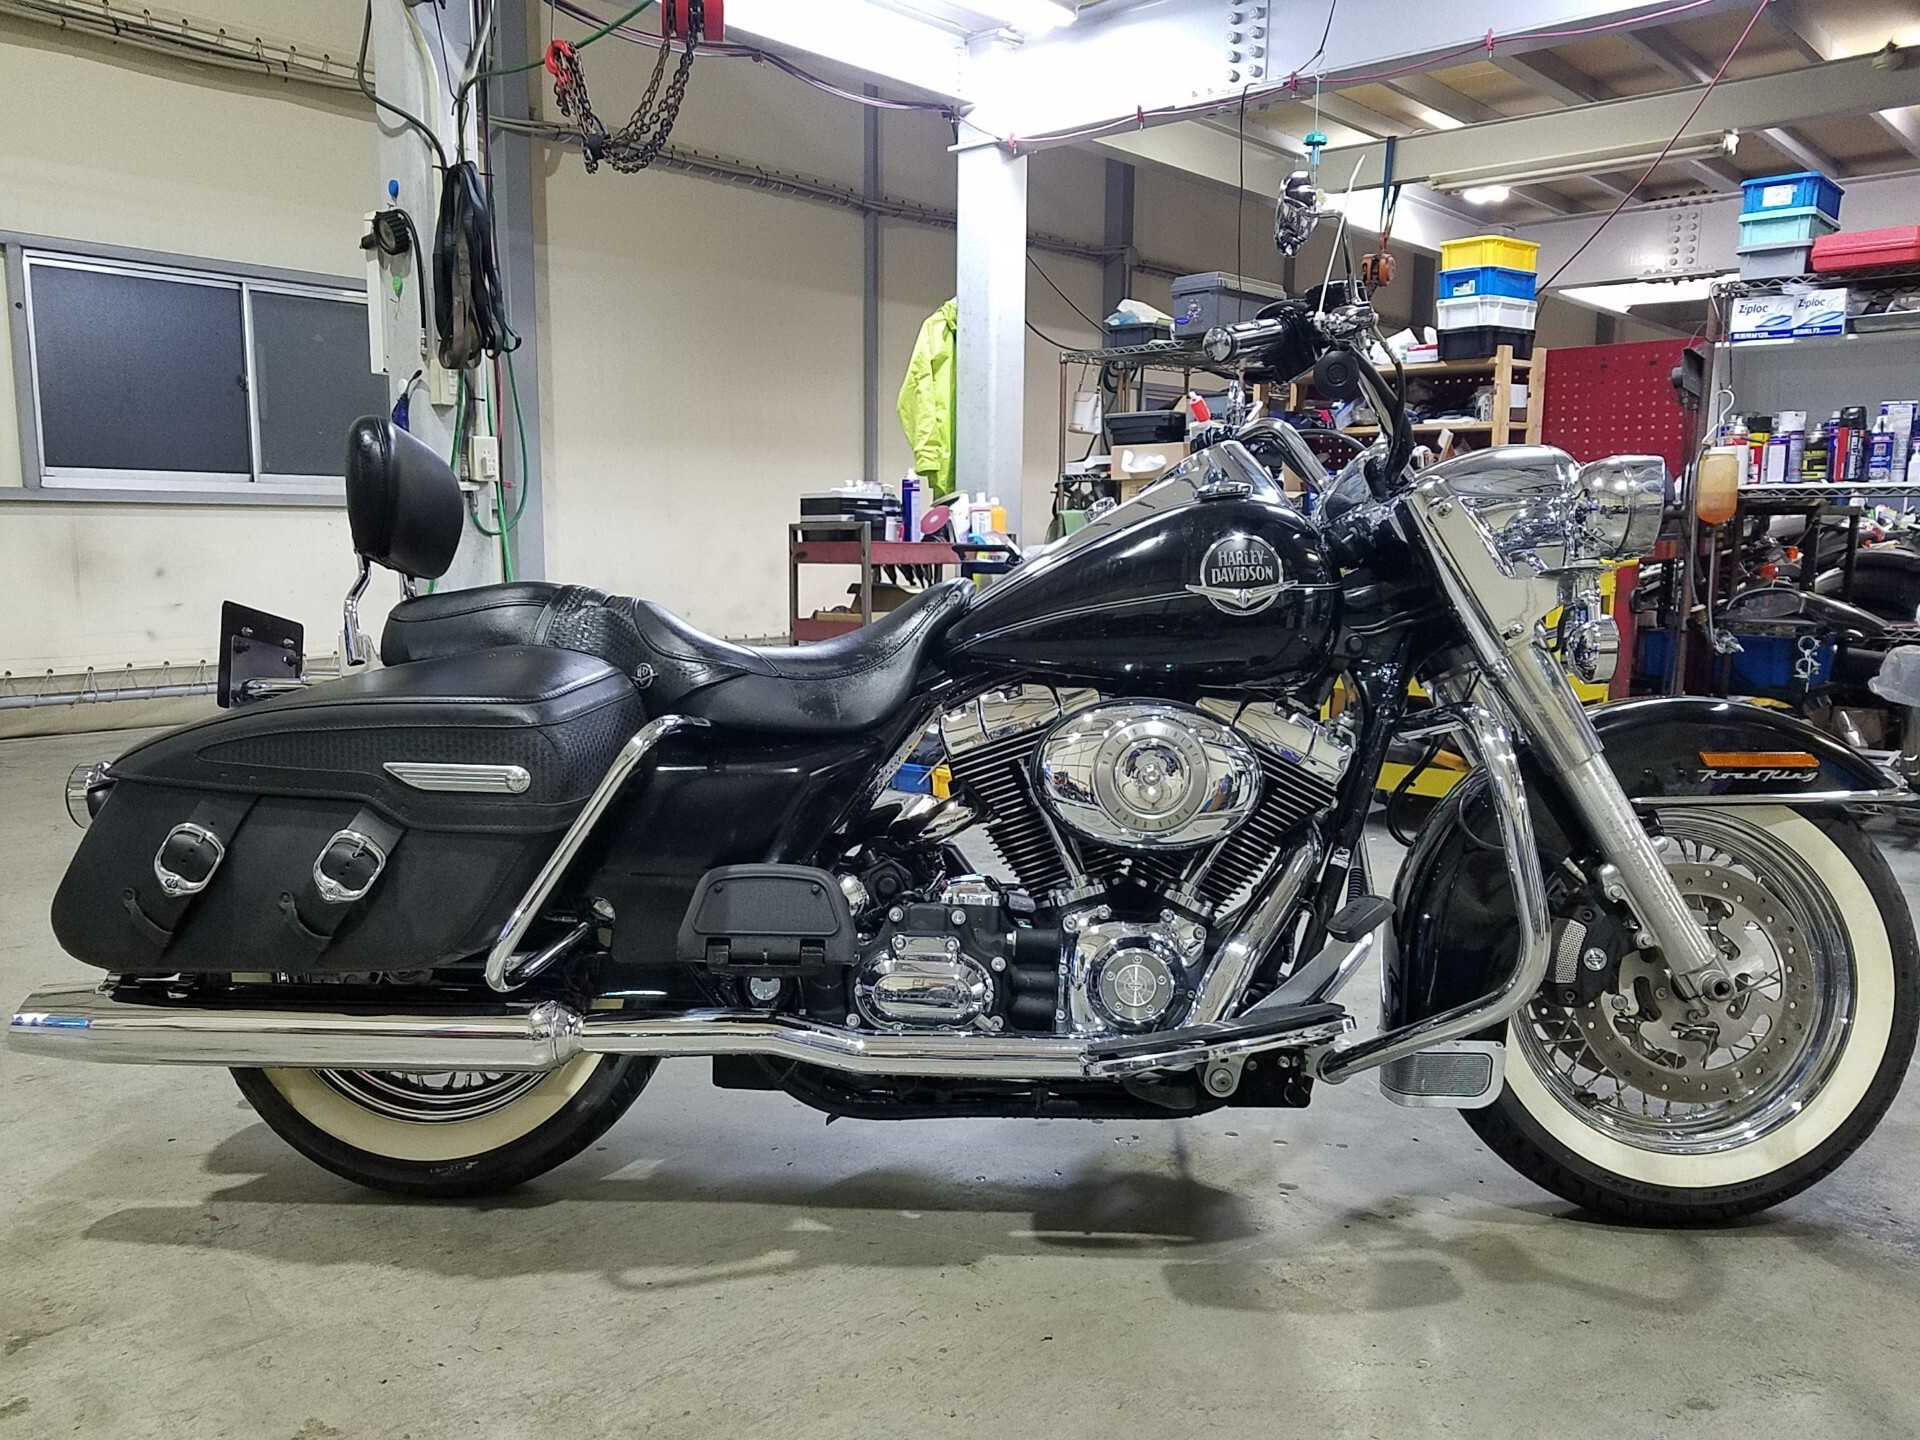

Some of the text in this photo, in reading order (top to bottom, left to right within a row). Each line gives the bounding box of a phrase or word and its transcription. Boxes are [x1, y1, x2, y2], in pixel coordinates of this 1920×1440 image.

[1739, 304, 1769, 315] Ziploc
[1798, 299, 1826, 309] Ziploc
[1218, 550, 1269, 566] HARLEY-
[1211, 565, 1274, 585] DAVIDSON
[1698, 769, 1818, 783] Road King
